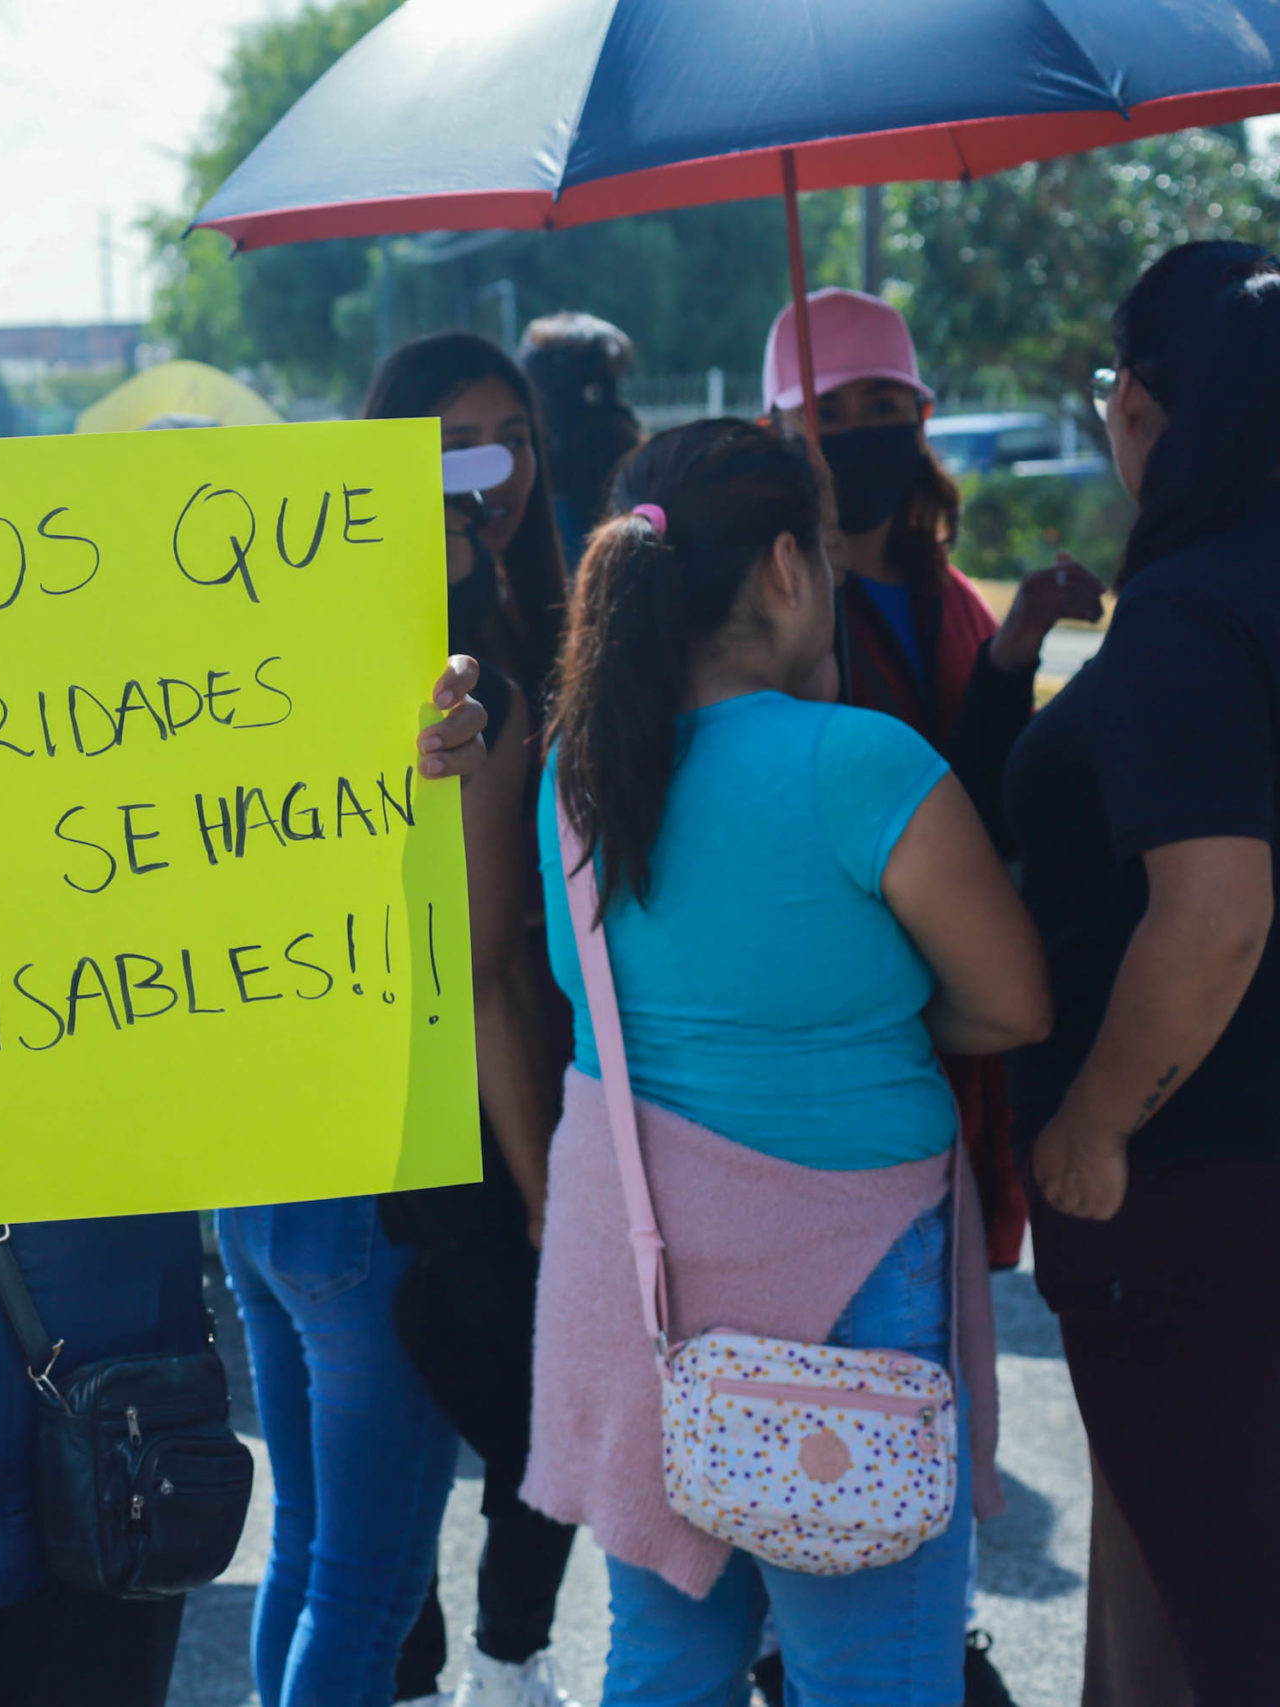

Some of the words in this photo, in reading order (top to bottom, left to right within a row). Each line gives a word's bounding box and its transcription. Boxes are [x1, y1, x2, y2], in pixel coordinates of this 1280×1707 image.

[173, 482, 384, 604] QUE
[54, 803, 170, 894] SE
[194, 765, 417, 866] HAGAN
